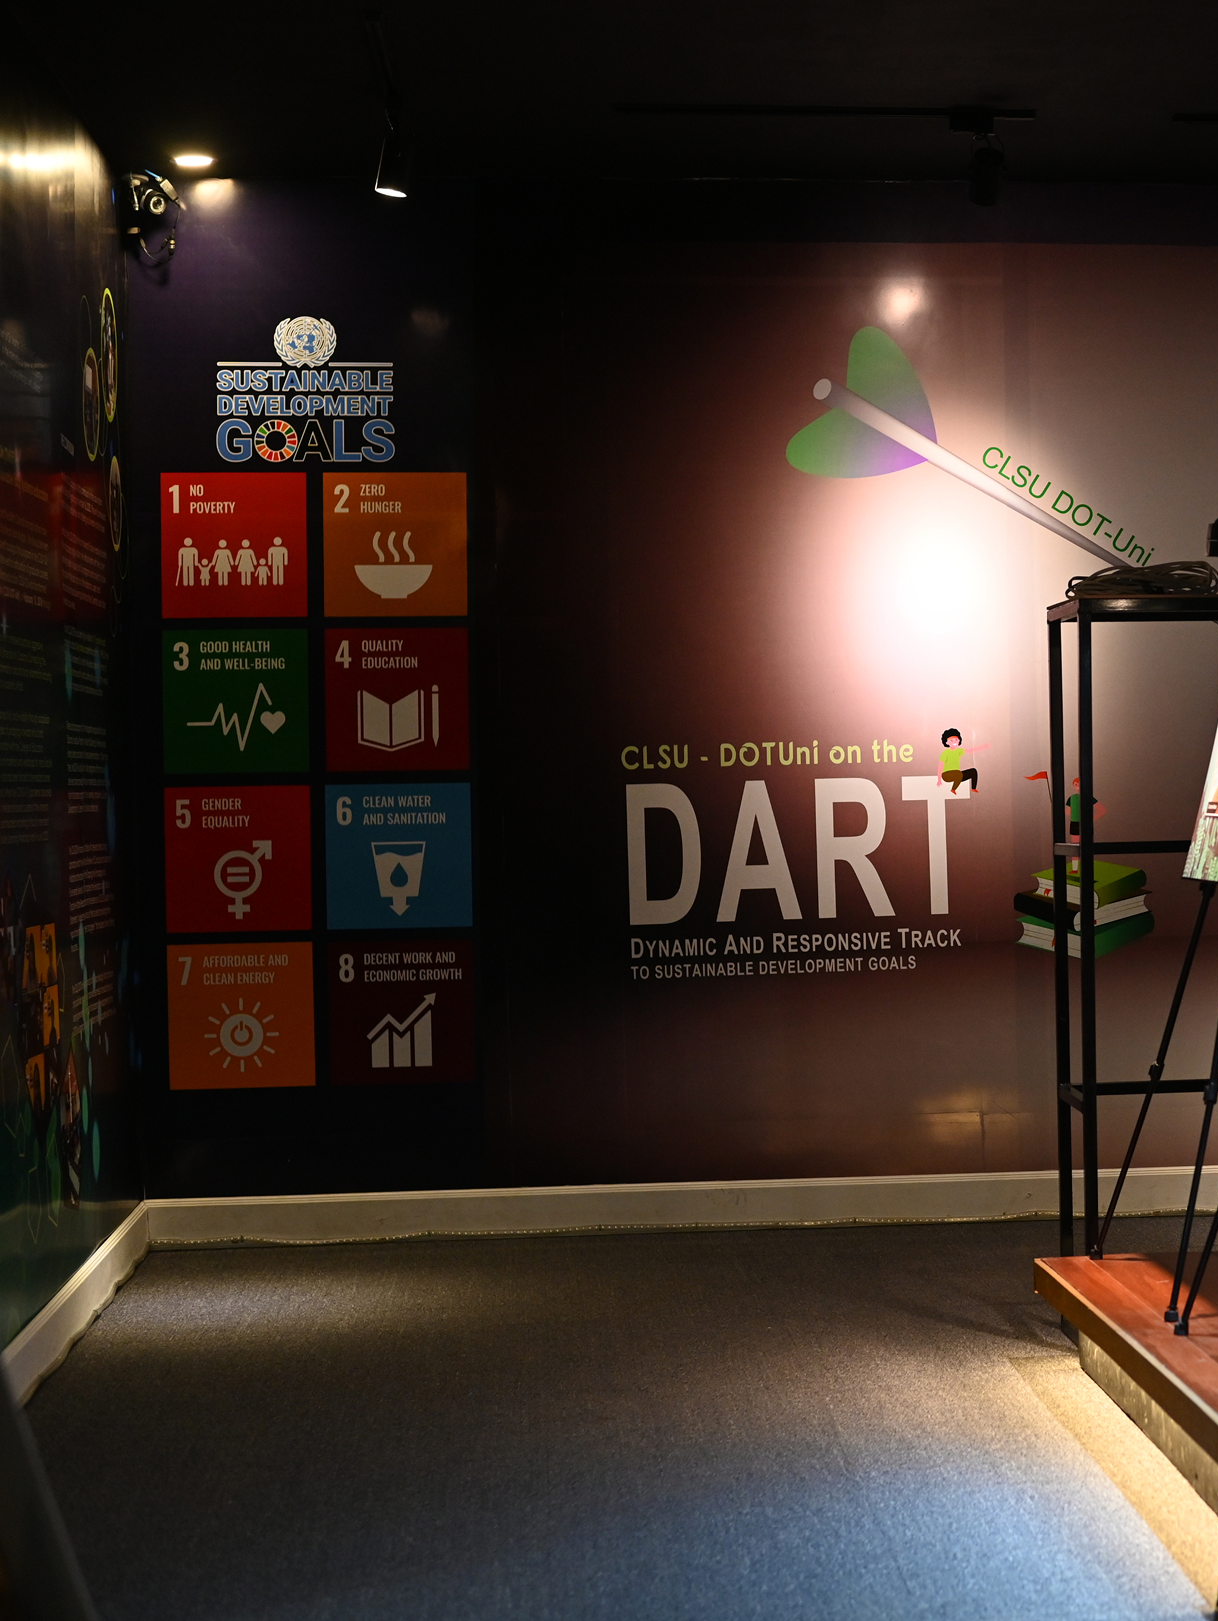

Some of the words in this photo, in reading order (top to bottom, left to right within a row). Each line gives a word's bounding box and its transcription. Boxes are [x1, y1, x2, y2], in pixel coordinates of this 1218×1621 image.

[216, 369, 393, 392] SUSTAINABLE
[216, 395, 393, 416] DEVELOPMENT
[216, 418, 395, 462] GOALS
[168, 484, 180, 514] 1
[189, 484, 204, 497] NO
[333, 484, 350, 514] 2
[360, 483, 386, 497] ZERO
[189, 501, 236, 514] POVERTY
[360, 501, 402, 514] HUNGER
[982, 446, 1052, 499] CLSU
[1051, 489, 1155, 567] DOT-Uni
[200, 641, 229, 654] GOOD
[232, 640, 271, 654] HEALTH
[335, 640, 352, 669] 4
[361, 639, 404, 654] QUALITY
[173, 641, 190, 671] 3
[200, 657, 221, 670] AND
[224, 657, 286, 670] WELL-BEING
[361, 656, 418, 669] EDUCATION
[621, 744, 690, 770] CLSU
[719, 739, 819, 767] DOTUni
[829, 745, 862, 764] on
[871, 738, 914, 763] the
[201, 798, 242, 811] GENDER
[336, 796, 353, 826] 6
[362, 795, 395, 809] CLEAN
[397, 795, 432, 808] WATER
[175, 799, 191, 829] 5
[201, 815, 250, 830] EQUALITY
[362, 812, 384, 825] AND
[386, 812, 447, 825] SANITATION
[625, 775, 971, 926] DART
[630, 934, 717, 959] DYNAMIC
[724, 932, 765, 955] AND
[772, 930, 892, 953] RESPONSIVE
[897, 928, 962, 949] TRACK
[202, 953, 266, 968] AFFORDABLE
[267, 953, 289, 967] AND
[363, 952, 400, 966] DECENT
[402, 951, 432, 965] WORK
[434, 951, 456, 964] AND
[630, 964, 650, 980] TO
[654, 961, 754, 979] SUSTAINABLE
[759, 957, 864, 975] DEVELOPMENT
[868, 955, 917, 971] GOALS
[178, 956, 192, 986] 7
[338, 953, 355, 983] 8
[363, 968, 417, 982] ECONOMIC
[418, 968, 463, 981] GROWTH
[203, 971, 235, 985] CLEAN
[237, 970, 275, 984] ENERGY
